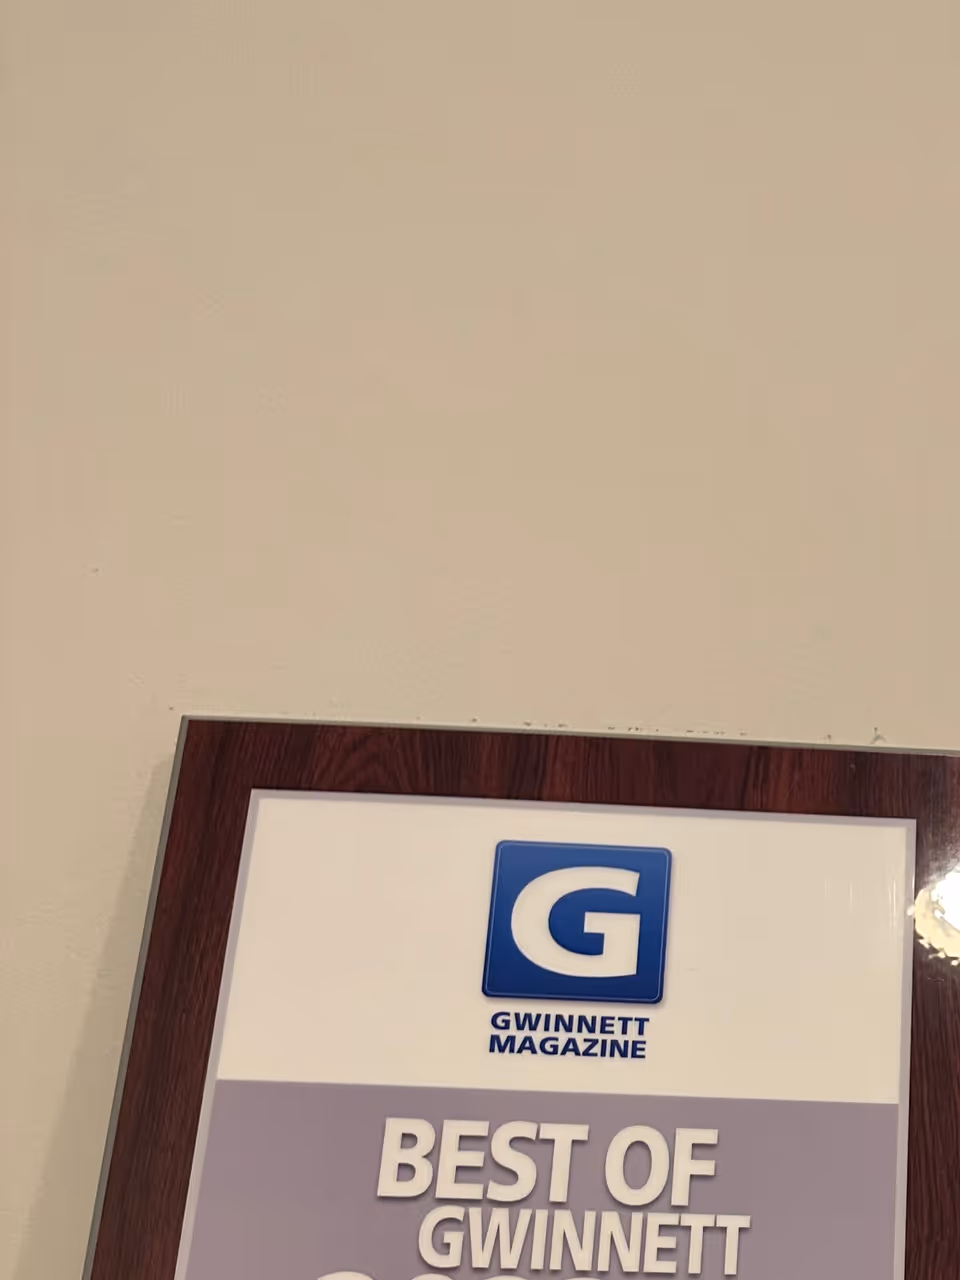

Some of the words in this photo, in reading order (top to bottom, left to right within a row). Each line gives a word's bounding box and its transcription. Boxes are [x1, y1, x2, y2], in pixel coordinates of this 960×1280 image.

[511, 866, 641, 978] G
[488, 1034, 647, 1059] MAGAZINE
[490, 1011, 650, 1036] GWINNETT
[376, 1117, 590, 1203] BEST
[604, 1125, 719, 1207] OF
[418, 1205, 752, 1276] GWINNETT
